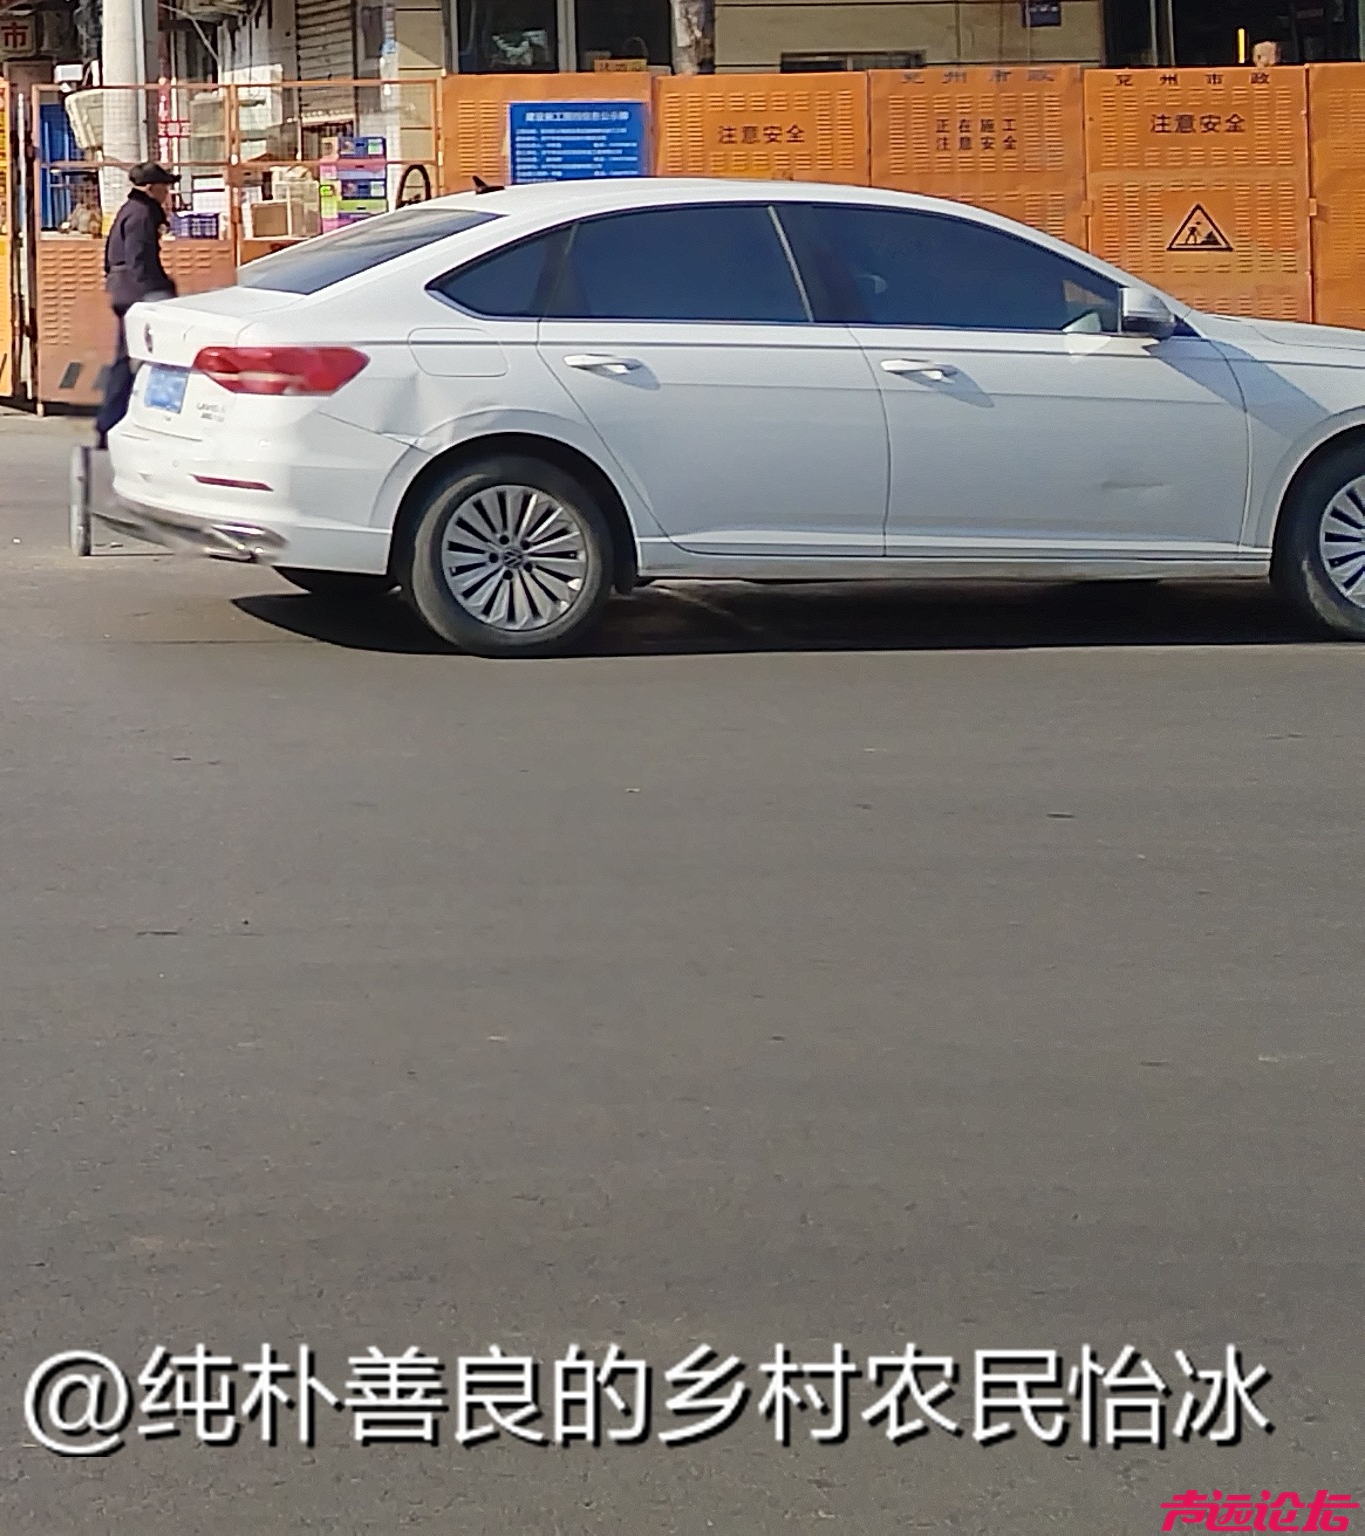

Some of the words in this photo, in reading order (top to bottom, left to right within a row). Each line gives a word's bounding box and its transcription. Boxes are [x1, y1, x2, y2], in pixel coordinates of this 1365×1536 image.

[936, 119, 1017, 133] 正在施工
[1150, 114, 1245, 134] 注意安全
[718, 124, 806, 144] 注意安全
[936, 136, 1017, 151] 注意安全
